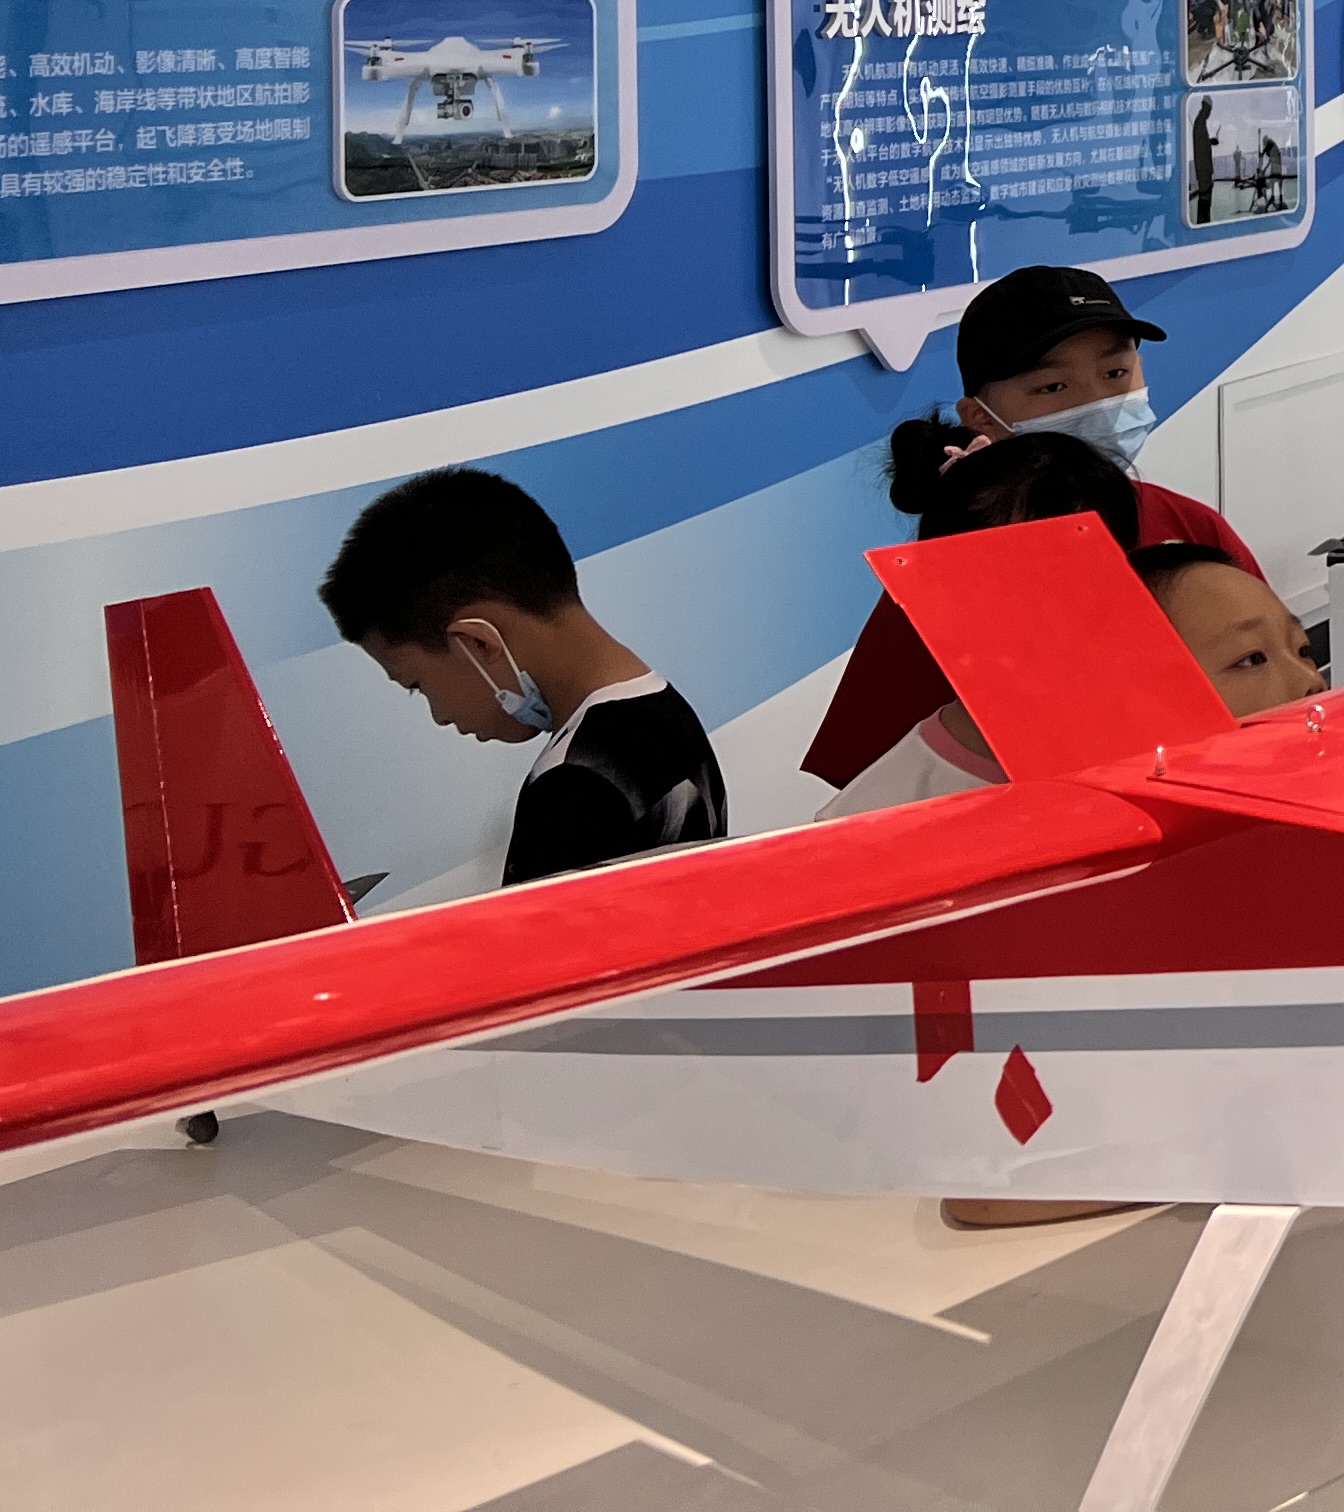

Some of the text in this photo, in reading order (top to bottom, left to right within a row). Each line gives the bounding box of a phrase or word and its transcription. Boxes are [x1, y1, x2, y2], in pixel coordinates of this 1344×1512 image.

[0, 47, 311, 79] 、高效机动、影像清晰、高度智能
[0, 83, 311, 118] 、水库、海岸线等带状地区航拍影
[0, 117, 311, 159] 的遥感平台，起飞降落受场地限制
[1, 157, 254, 199] 具有较强的稳定性和安全性。
